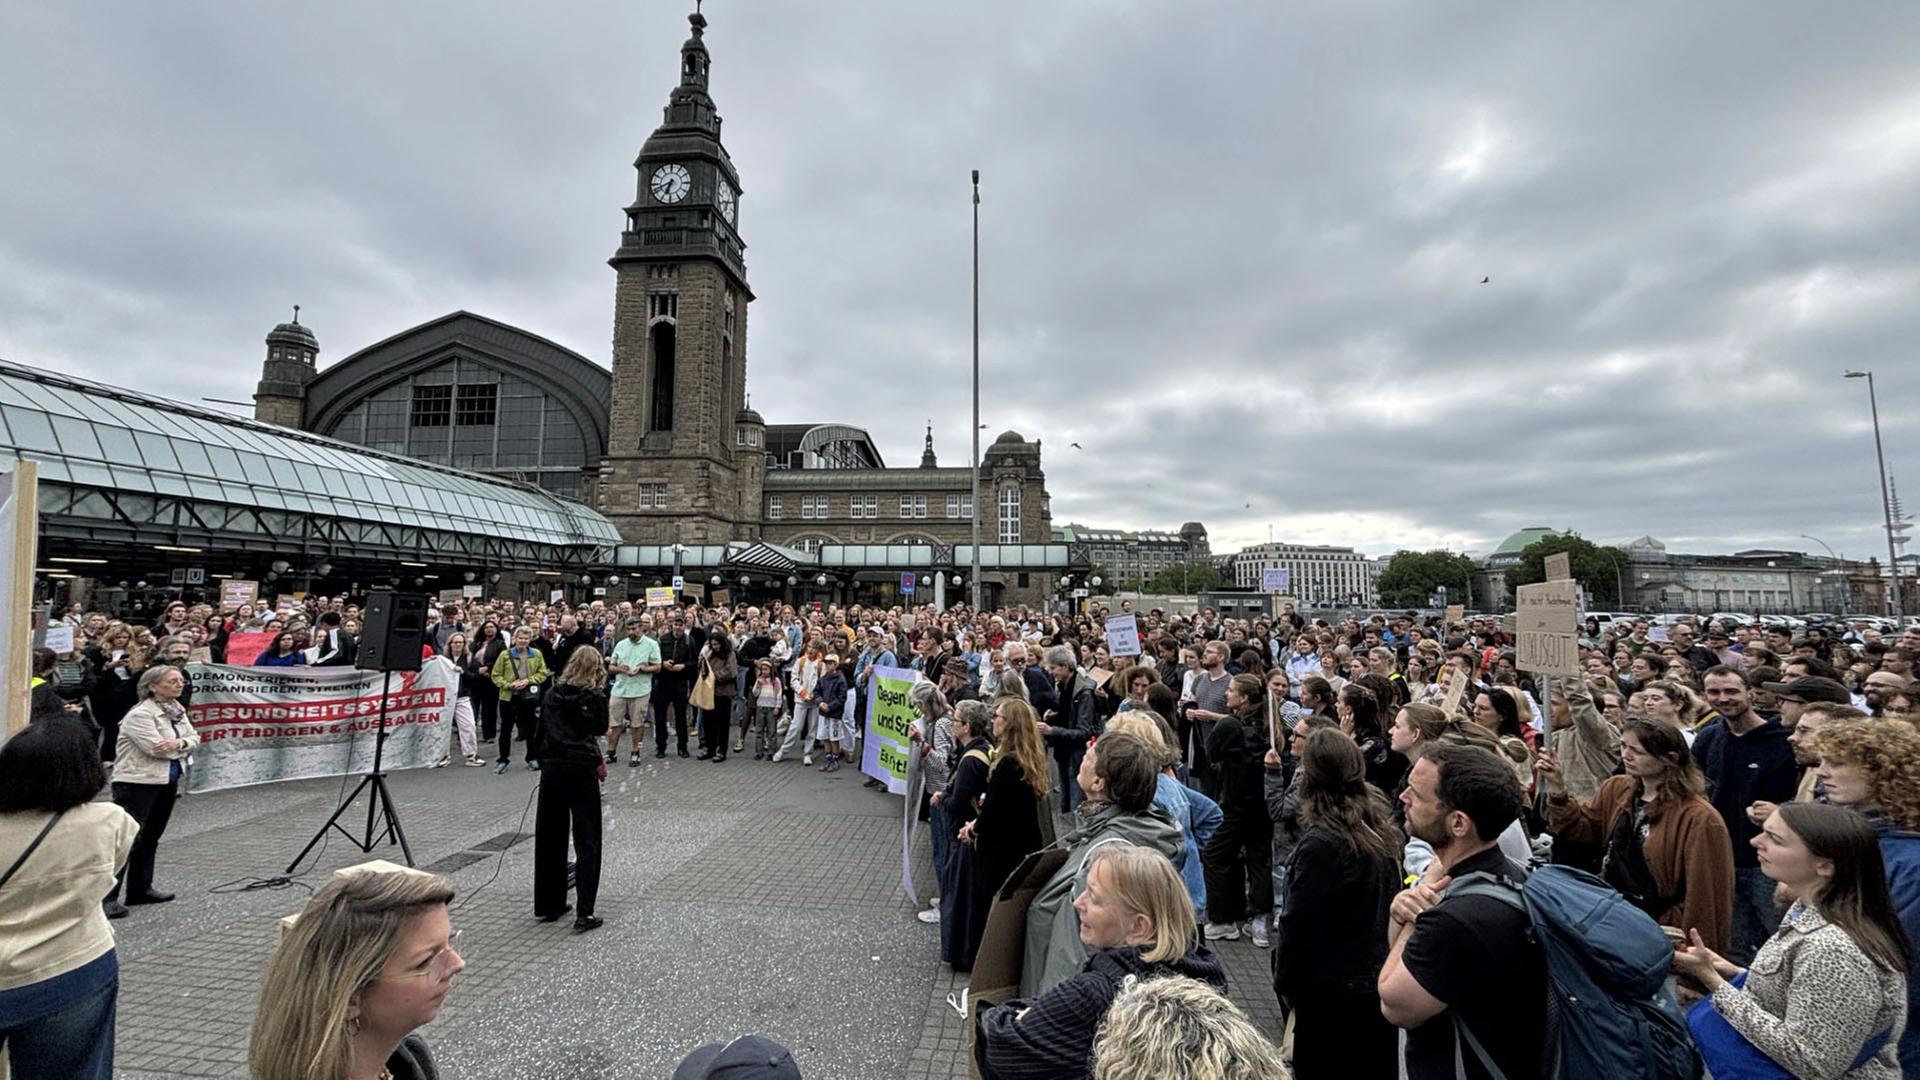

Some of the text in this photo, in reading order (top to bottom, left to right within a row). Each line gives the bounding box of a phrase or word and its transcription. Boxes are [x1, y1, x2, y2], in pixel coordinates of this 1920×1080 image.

[191, 682, 371, 695] ORGANISIEREN, STREIKEN
[192, 672, 319, 685] DEMONSTRIEREN,
[877, 684, 906, 707] Gegen
[191, 692, 441, 723] GESUNDHEITSSYSTEM
[199, 712, 440, 744] ERTEIDIGEN & AUSBAUEN
[877, 713, 894, 731] und
